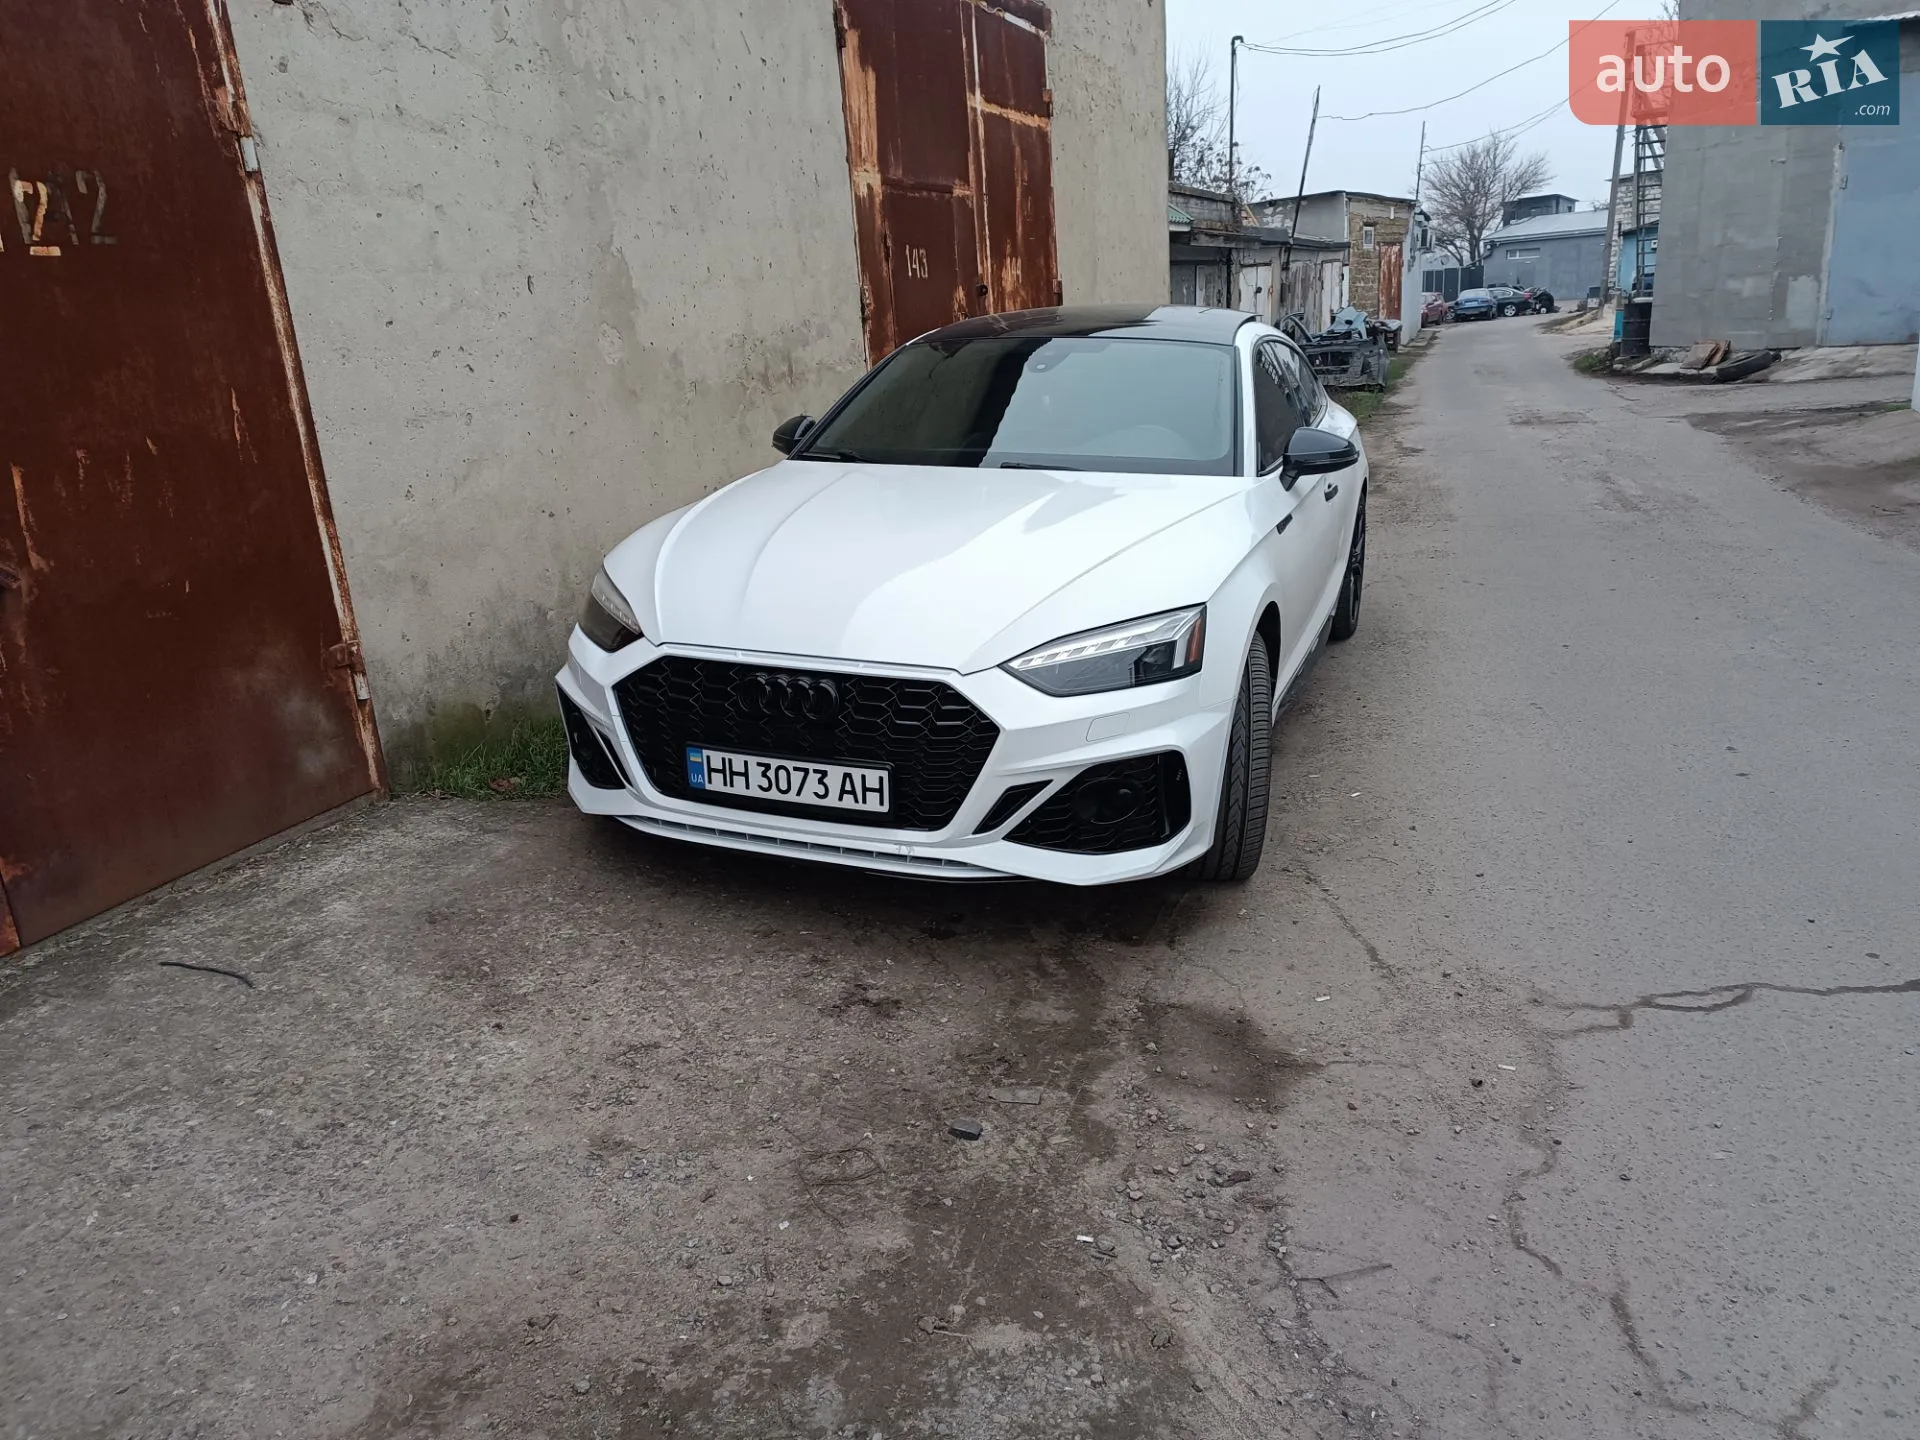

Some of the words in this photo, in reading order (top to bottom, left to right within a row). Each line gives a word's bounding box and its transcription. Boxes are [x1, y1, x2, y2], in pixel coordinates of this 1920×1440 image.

[905, 244, 929, 279] 143
[691, 773, 704, 784] UA
[706, 754, 750, 790] HH
[756, 761, 830, 800] 3073
[838, 772, 885, 807] AH
